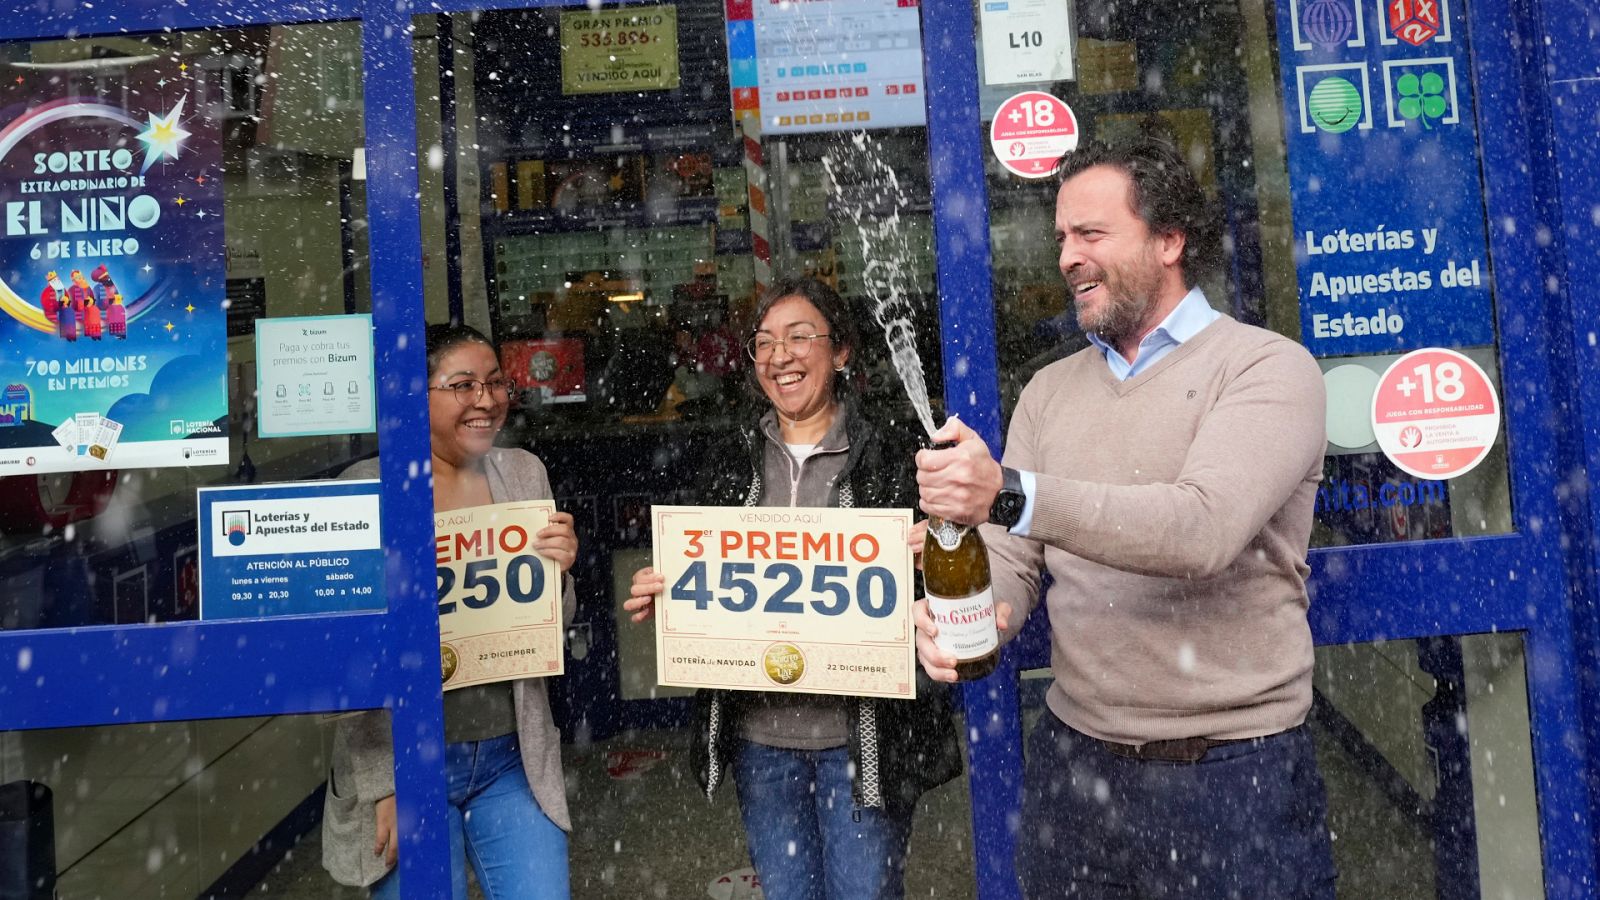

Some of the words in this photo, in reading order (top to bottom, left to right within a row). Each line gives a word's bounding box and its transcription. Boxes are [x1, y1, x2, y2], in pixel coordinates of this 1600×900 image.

[573, 19, 610, 30] GRAN
[614, 15, 662, 28] PREMIO
[1008, 31, 1042, 48] L10
[578, 70, 628, 82] VENDIDO
[1008, 99, 1055, 128] +18
[34, 148, 132, 174] SORTEO
[21, 177, 128, 194] EXTRAORDINARIO
[130, 176, 146, 188] DE
[6, 200, 48, 236] EL
[62, 194, 160, 233] NIÑO
[1306, 224, 1414, 255] Loterías
[1422, 228, 1438, 254] y
[30, 242, 41, 260] 6
[47, 242, 70, 258] DE
[76, 238, 139, 258] ENERO
[1310, 266, 1432, 302] Apuestas
[1440, 260, 1480, 288] del
[1312, 308, 1404, 338] Estado
[280, 343, 300, 354] Paga
[303, 344, 308, 352] y
[311, 341, 334, 350] cobra
[26, 359, 60, 376] 700
[66, 356, 147, 374] MILLONES
[273, 356, 308, 368] premios
[328, 354, 356, 362] Bizum
[48, 378, 66, 391] EN
[70, 375, 130, 390] PREMIOS
[1396, 362, 1465, 404] +18
[1386, 410, 1406, 418] JUEGA
[1424, 404, 1484, 414] RESPONSABILIDAD
[186, 420, 214, 428] LOTERÍA
[186, 426, 222, 434] NACIONAL
[254, 511, 300, 522] Loterías
[303, 512, 310, 524] y
[448, 512, 474, 528] AQUÍ
[740, 513, 792, 524] VENDIDO
[794, 512, 822, 524] AQUÍ
[256, 524, 308, 536] Apuestas
[311, 522, 328, 532] del
[330, 521, 370, 531] Estado
[436, 525, 528, 564] EMIO
[684, 530, 712, 558] 3er
[720, 530, 880, 563] PREMIO
[246, 560, 293, 570] ATENCIÓN
[295, 560, 307, 568] AL
[309, 557, 350, 568] PÚBLICO
[232, 576, 252, 584] lunes
[260, 575, 288, 583] viernes
[326, 572, 354, 580] sábado
[314, 588, 335, 597] 10,00
[352, 586, 372, 596] 14,00
[436, 554, 545, 615] 250
[671, 561, 897, 618] 45250
[232, 592, 252, 600] 09,30
[268, 590, 289, 600] 20,30
[937, 613, 950, 624] EL
[950, 604, 994, 625] GAITERO
[491, 648, 536, 660] DICIEMBRE
[672, 656, 706, 665] LOTERÍA
[716, 658, 756, 667] NAVIDAD
[840, 664, 887, 673] DICIEMBRE
